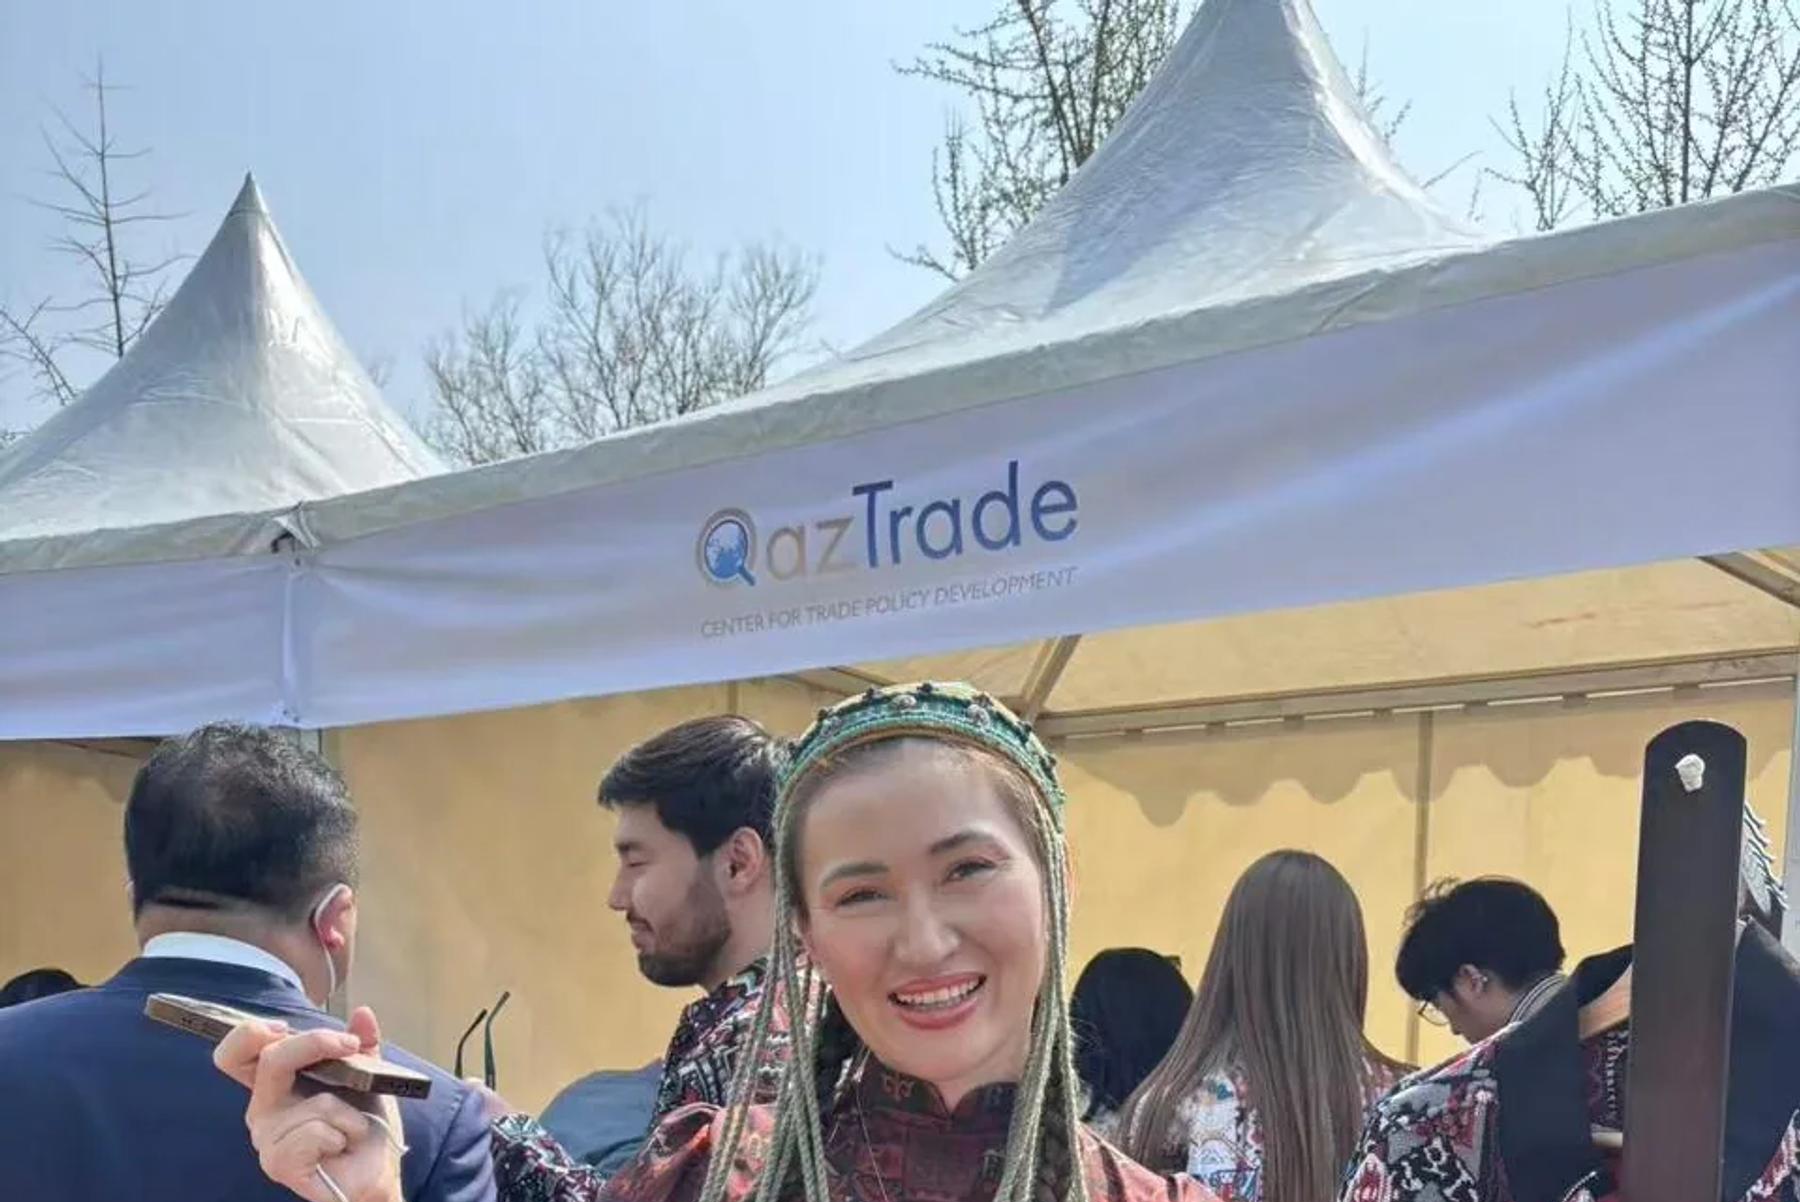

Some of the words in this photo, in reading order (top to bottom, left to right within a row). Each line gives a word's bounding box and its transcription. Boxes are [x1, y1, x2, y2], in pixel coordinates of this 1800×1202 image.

[697, 460, 1078, 588] QazTrade
[700, 613, 765, 638] CENTER
[768, 610, 800, 630] FOR
[804, 599, 863, 623] TRADE
[865, 587, 931, 616] POLICY
[935, 566, 1079, 606] DEVELOPMENT
